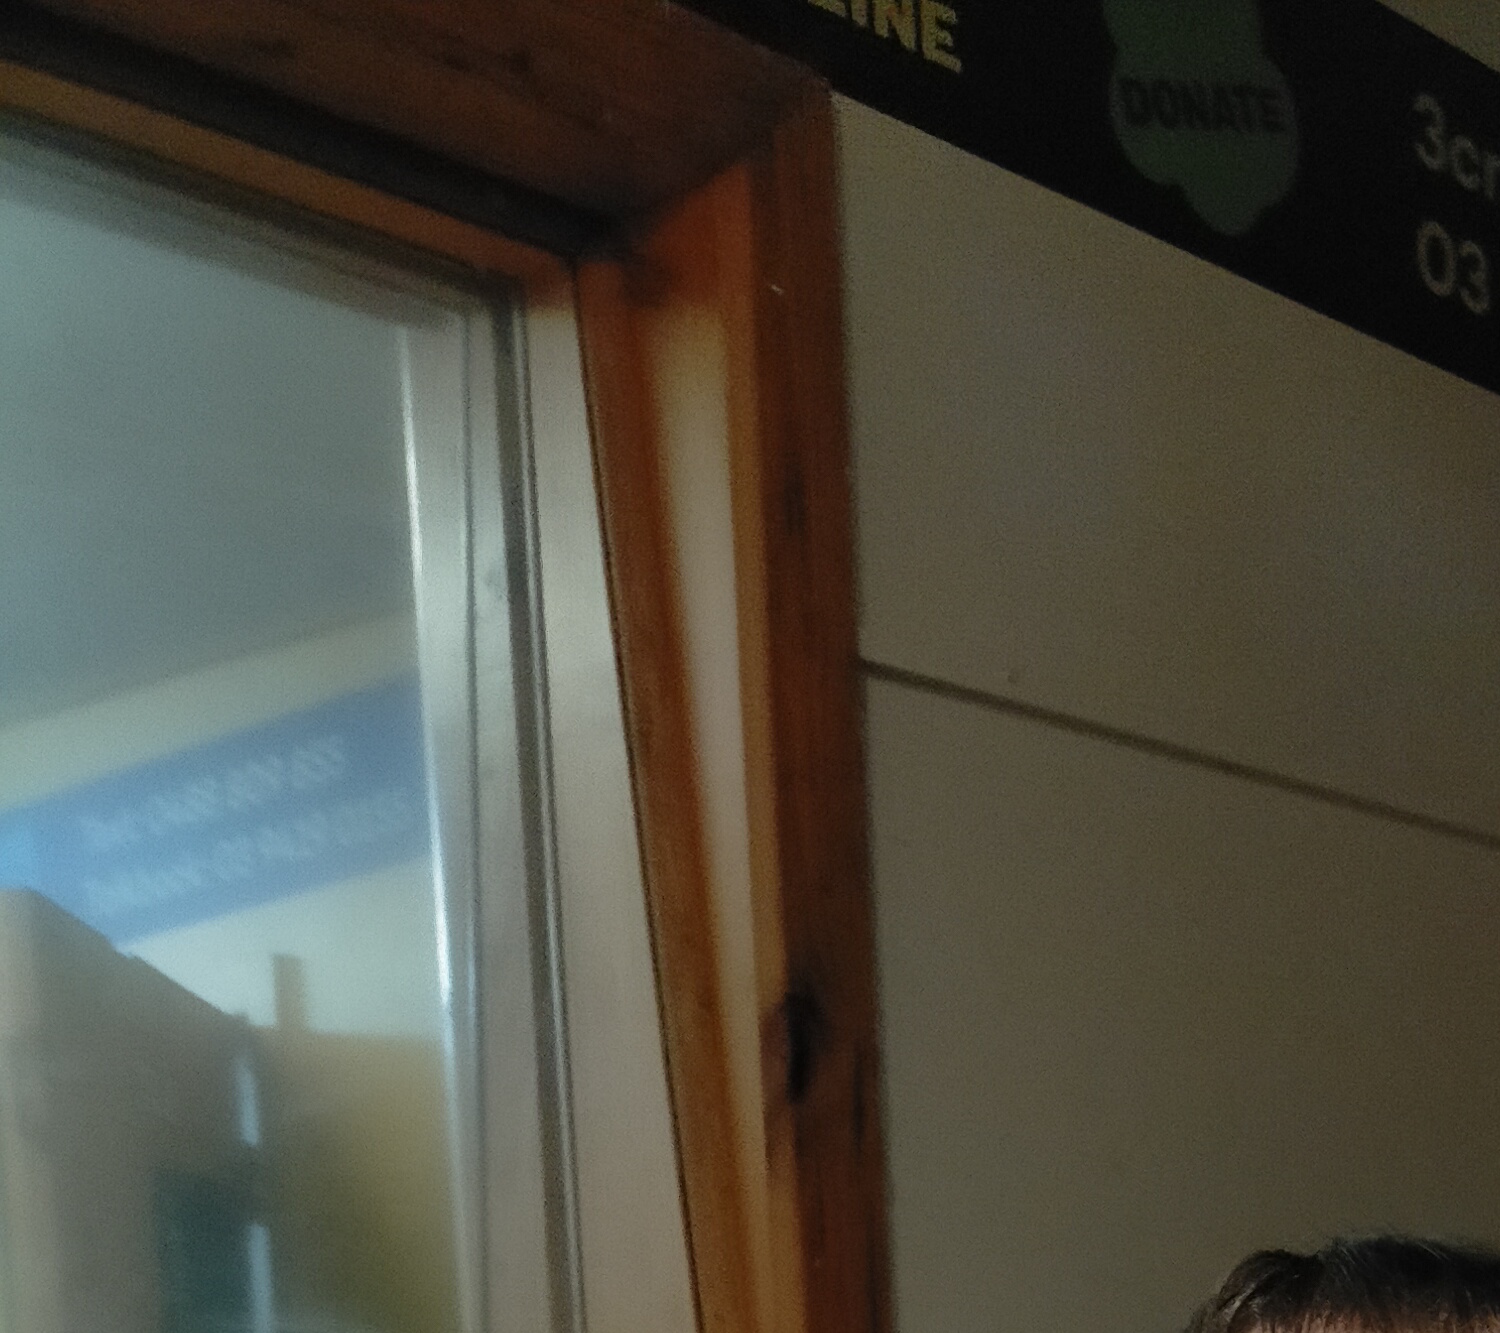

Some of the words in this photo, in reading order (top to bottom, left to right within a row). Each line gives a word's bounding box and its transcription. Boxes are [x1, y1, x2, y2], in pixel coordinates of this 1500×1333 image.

[807, 0, 963, 74] NE
[1118, 78, 1285, 135] DONATE
[1415, 219, 1491, 316] 03
